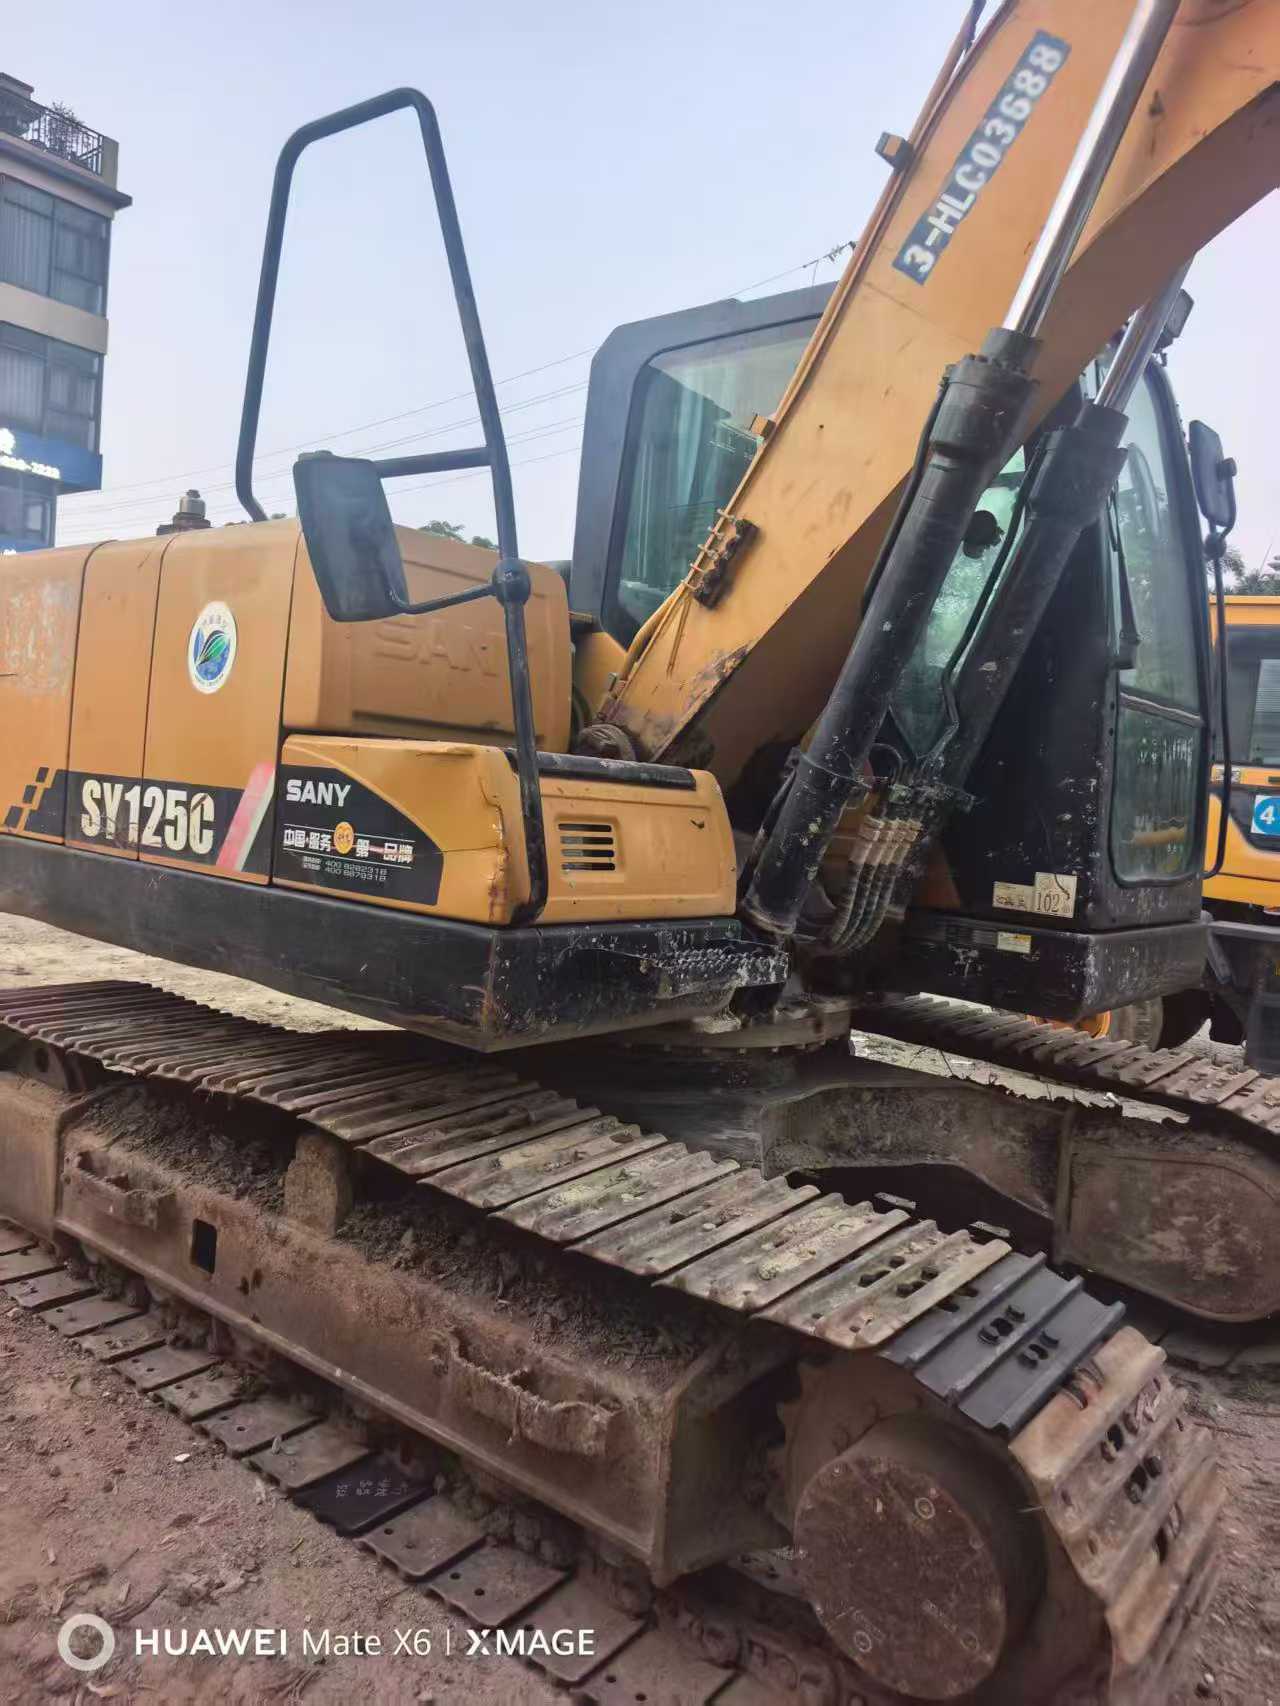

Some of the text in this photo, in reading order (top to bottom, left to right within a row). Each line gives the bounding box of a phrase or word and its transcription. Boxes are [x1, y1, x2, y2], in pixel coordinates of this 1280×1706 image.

[903, 44, 1063, 274] 3-HLC03688
[80, 779, 215, 855] SY125C
[286, 779, 351, 807] SANY
[1260, 805, 1276, 825] 4
